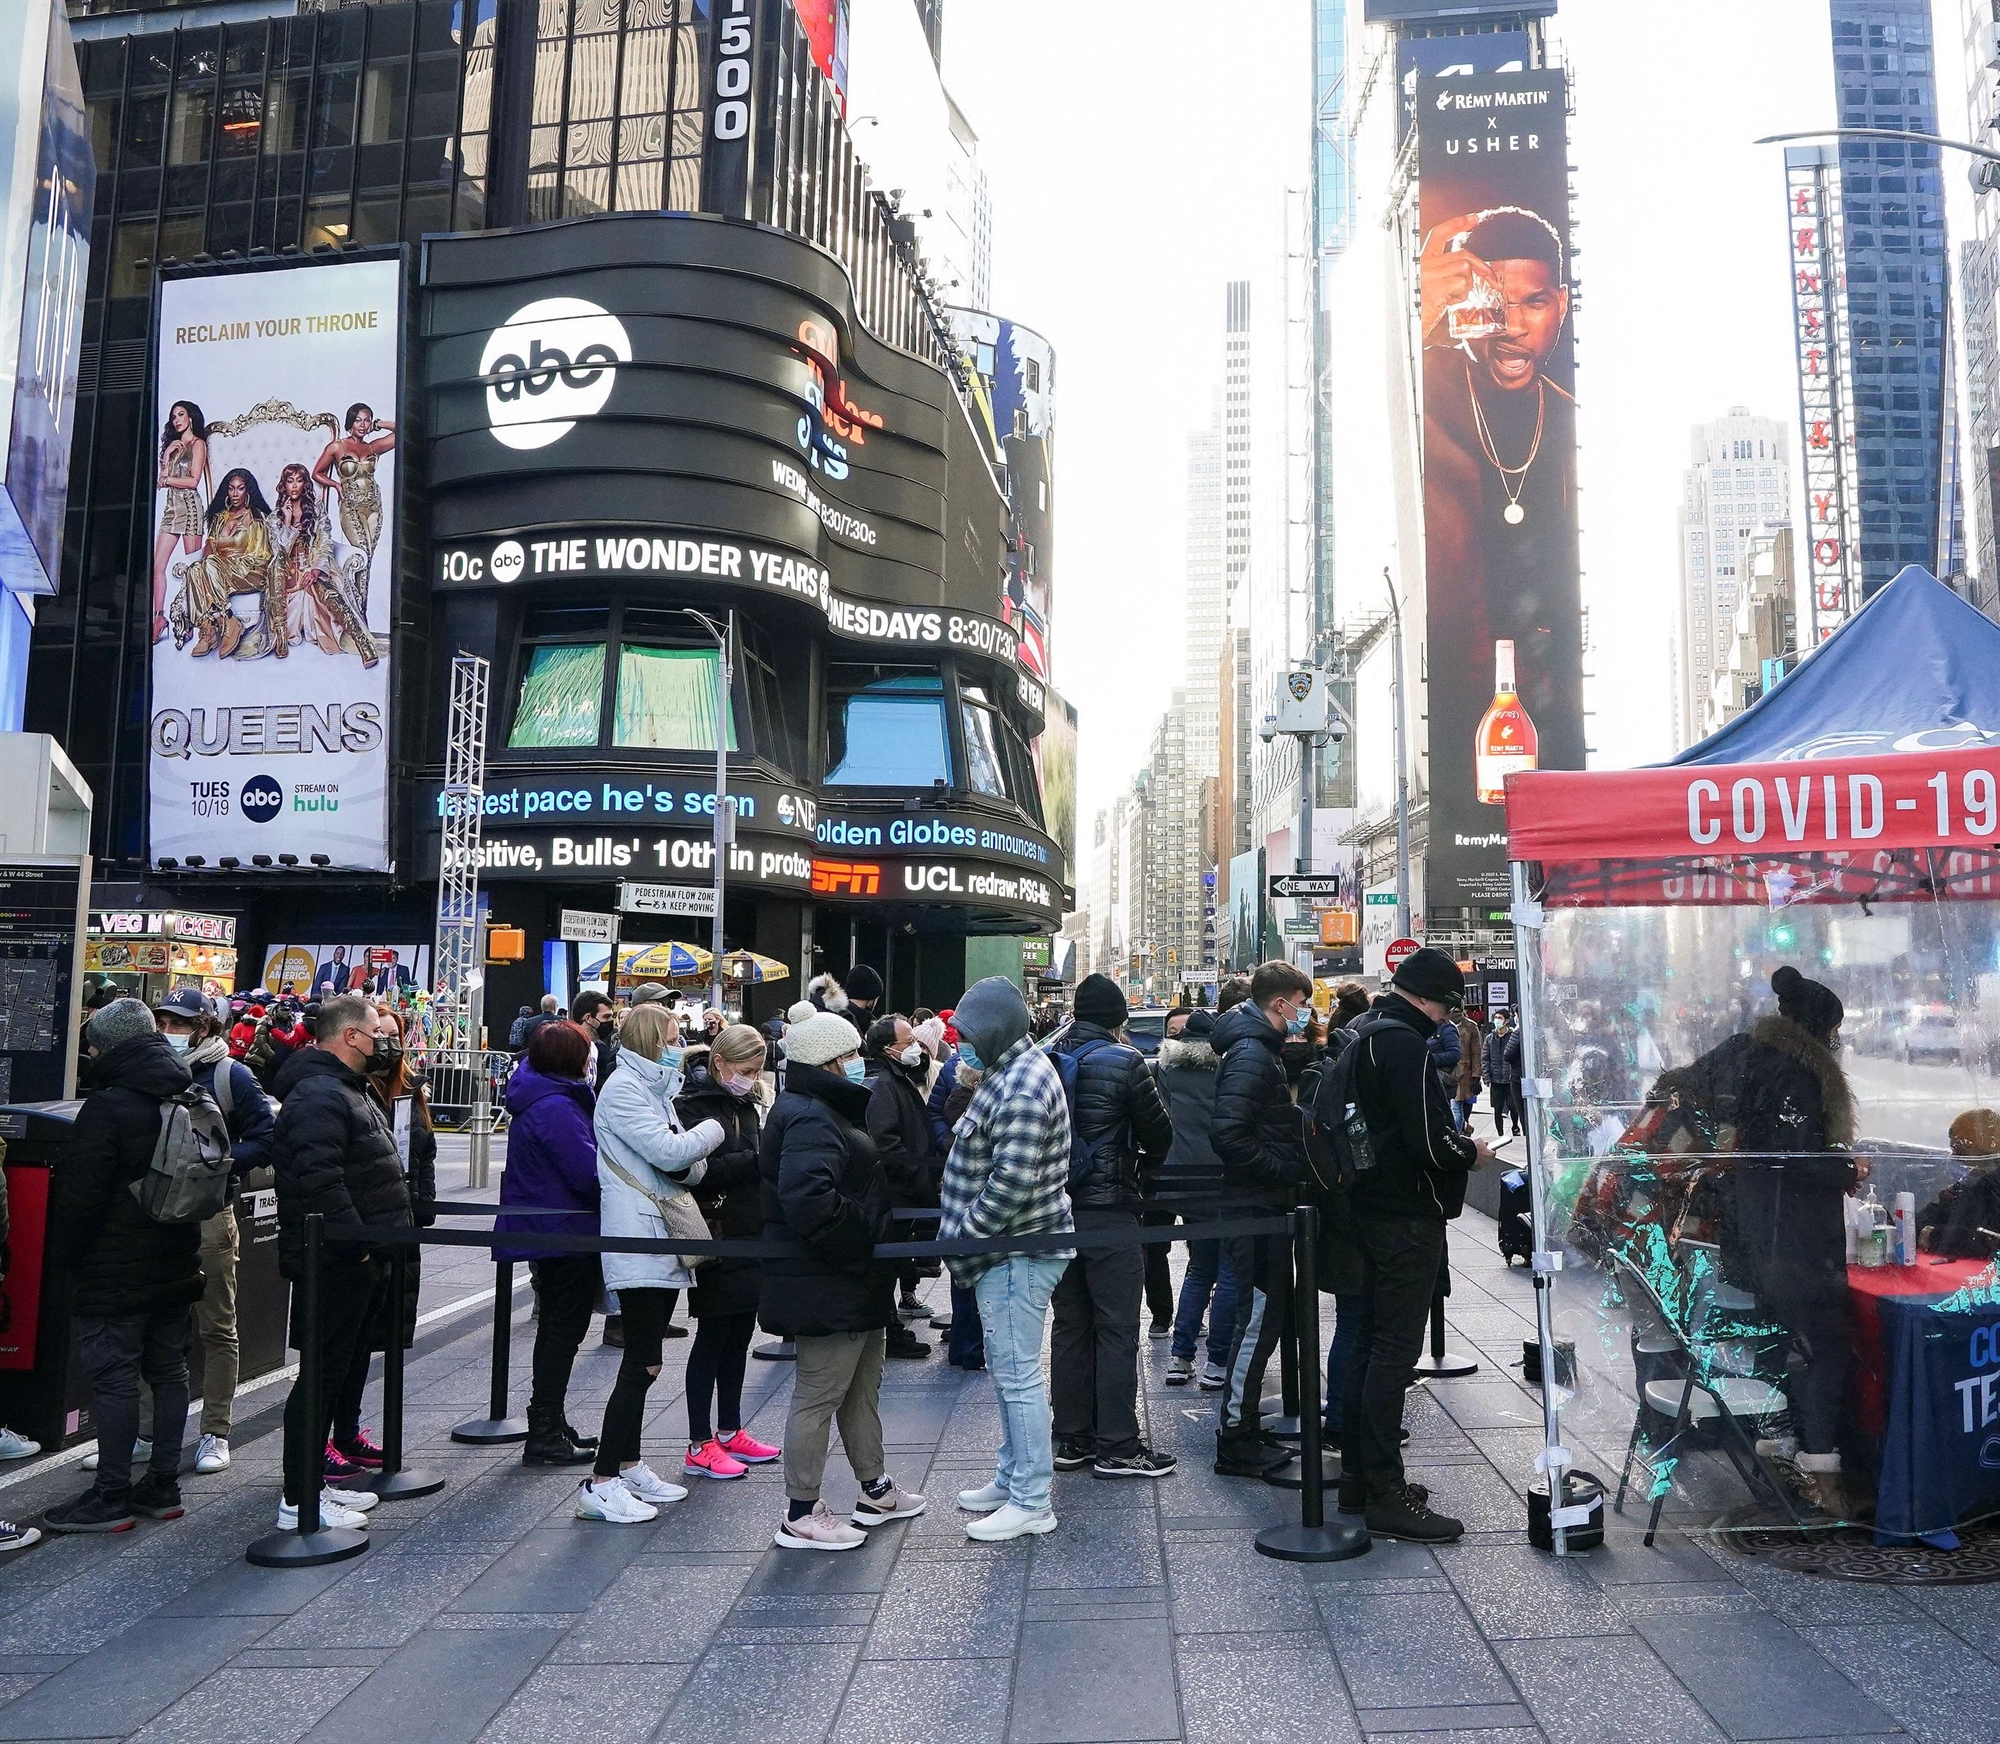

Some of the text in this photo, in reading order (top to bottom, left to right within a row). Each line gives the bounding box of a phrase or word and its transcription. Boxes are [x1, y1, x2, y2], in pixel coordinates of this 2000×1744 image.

[1495, 91, 1547, 107] MARTIN
[1446, 134, 1539, 155] USHER
[1796, 188, 1820, 376] ERNST
[176, 311, 378, 344] RECLAIM YOUR THRONE
[489, 340, 619, 402] abc
[494, 554, 521, 568] abc
[531, 539, 587, 573] THE
[596, 538, 741, 577] WONDER
[749, 549, 818, 597] YEARS
[151, 702, 382, 761] QUEENS
[190, 781, 230, 798] TUES
[243, 789, 281, 806] abc
[294, 784, 338, 793] STREAM ON
[191, 799, 229, 817] 10/19
[294, 795, 338, 812] hulu
[524, 790, 592, 818] pace
[603, 783, 674, 812] he's
[684, 792, 755, 817] sen
[1687, 769, 1998, 844] COVID-19
[795, 796, 817, 832] NE
[889, 820, 977, 846] Globes
[982, 829, 1038, 861] announces
[552, 837, 640, 867] Bulls'
[653, 839, 716, 868] 10th
[730, 843, 754, 870] in
[904, 866, 963, 892] UCL
[968, 872, 1018, 899] redraw:
[1280, 882, 1330, 891] ONE WAY
[635, 888, 715, 901] PEDESTRIAN FLOW ZONE
[1367, 895, 1374, 904] W
[1377, 895, 1389, 904] 44
[670, 902, 714, 913] KEEP MOVING
[101, 914, 142, 932] VEG
[598, 918, 608, 927] ZONE
